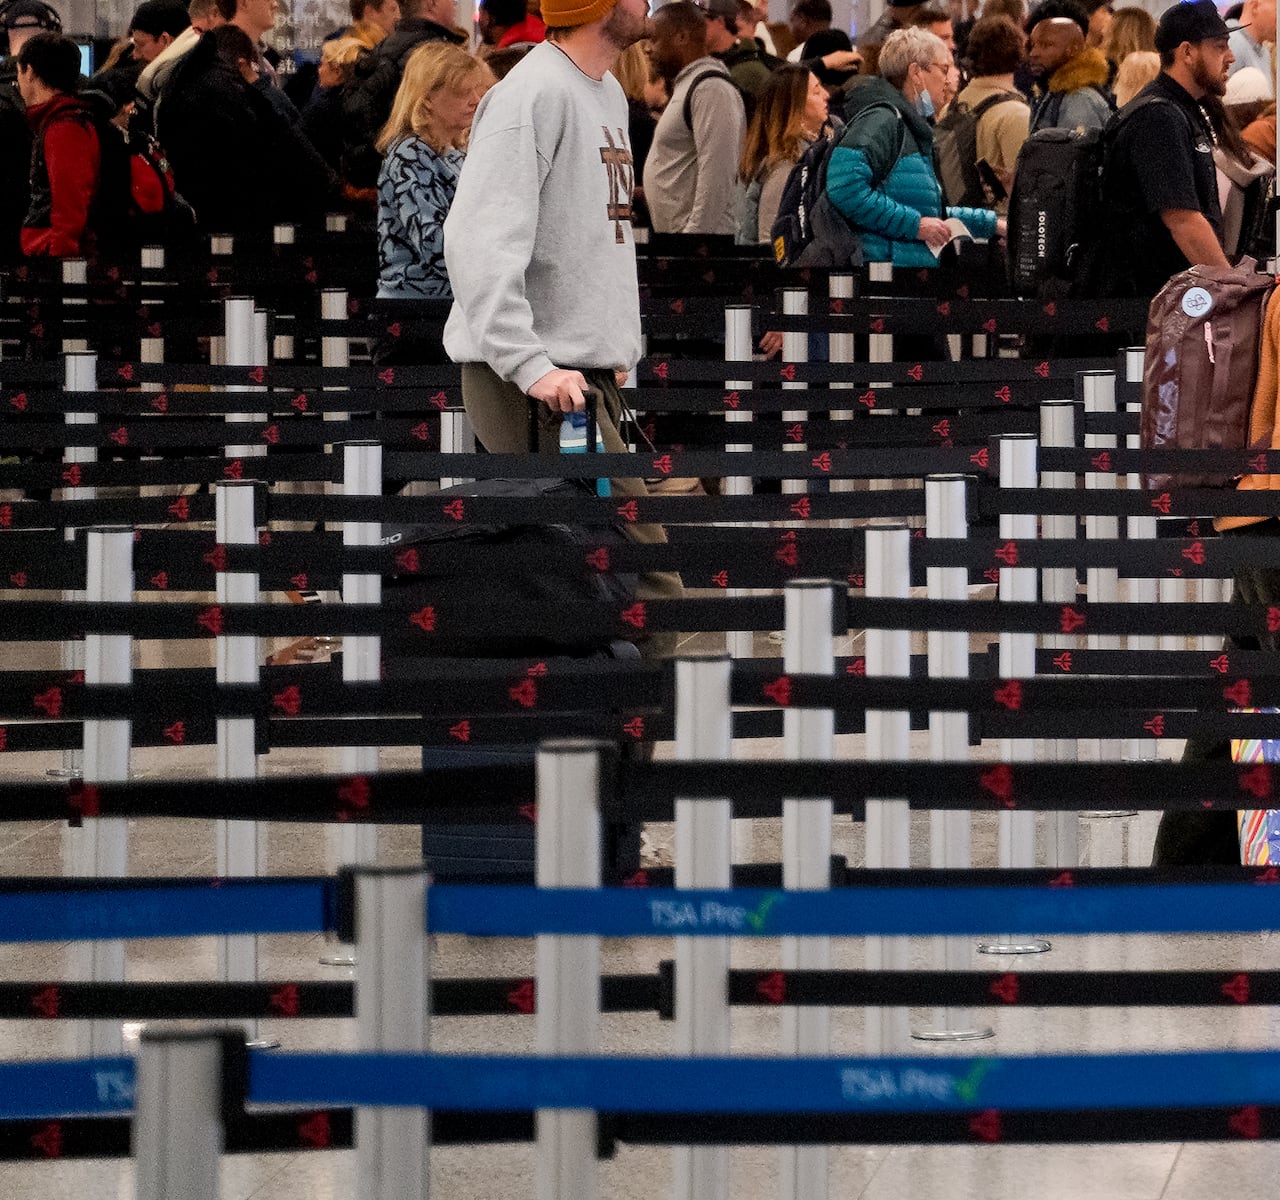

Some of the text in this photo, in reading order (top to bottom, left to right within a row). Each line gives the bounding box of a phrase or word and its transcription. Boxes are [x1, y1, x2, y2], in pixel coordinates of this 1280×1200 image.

[1038, 210, 1046, 257] SOLOTECH
[651, 901, 746, 928] TSA Pre
[842, 1068, 954, 1099] TSA Pre
